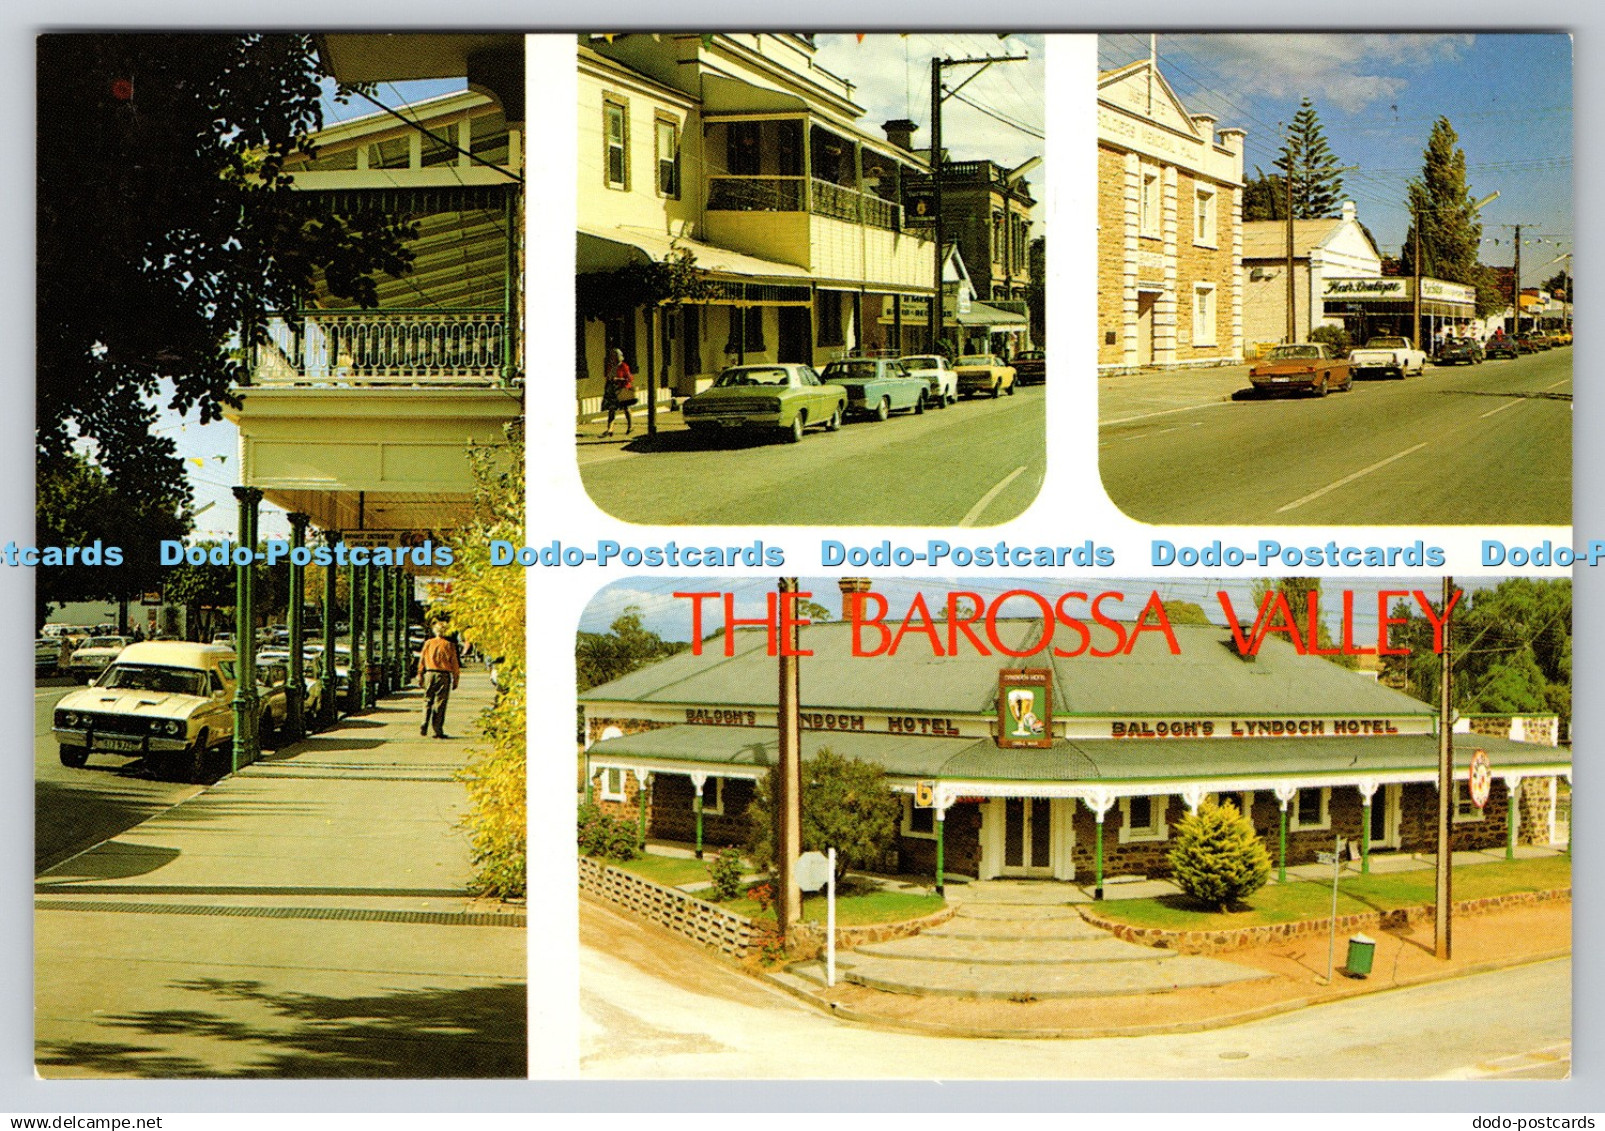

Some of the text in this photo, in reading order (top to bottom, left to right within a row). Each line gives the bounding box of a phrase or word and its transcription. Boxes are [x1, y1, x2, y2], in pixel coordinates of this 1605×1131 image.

[887, 716, 960, 736] HOTEL
[1111, 719, 1399, 738] BALOGH'S LYNDOCH HOTEL
